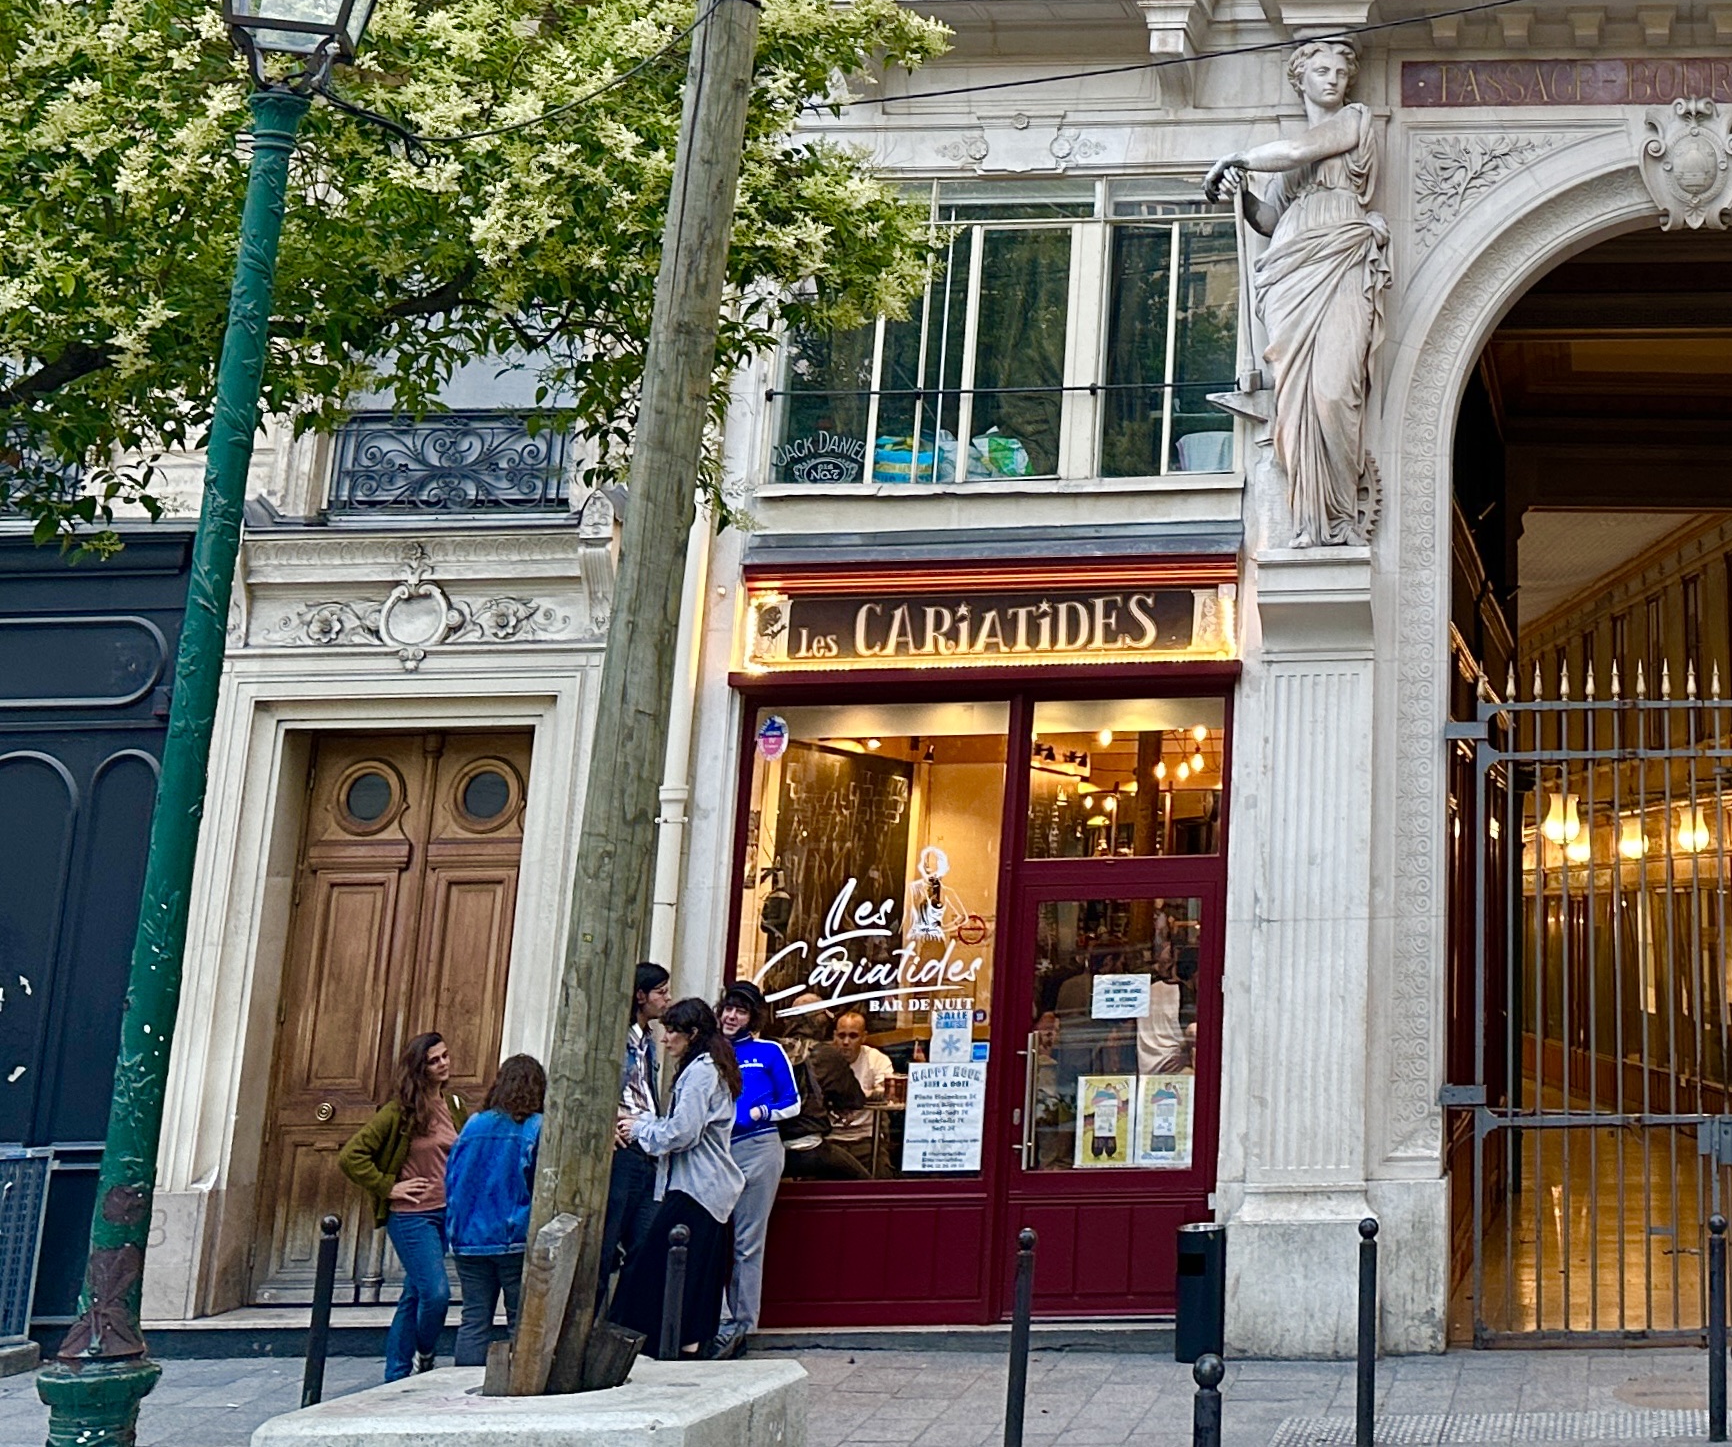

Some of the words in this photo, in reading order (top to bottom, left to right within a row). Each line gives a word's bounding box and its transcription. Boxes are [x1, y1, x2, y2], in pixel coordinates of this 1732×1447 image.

[773, 437, 814, 466] JACK
[818, 878, 894, 940] Les
[754, 939, 983, 1002] Cariatides
[869, 998, 904, 1013] BAR
[908, 998, 931, 1012] DE
[933, 997, 975, 1011] NUIT
